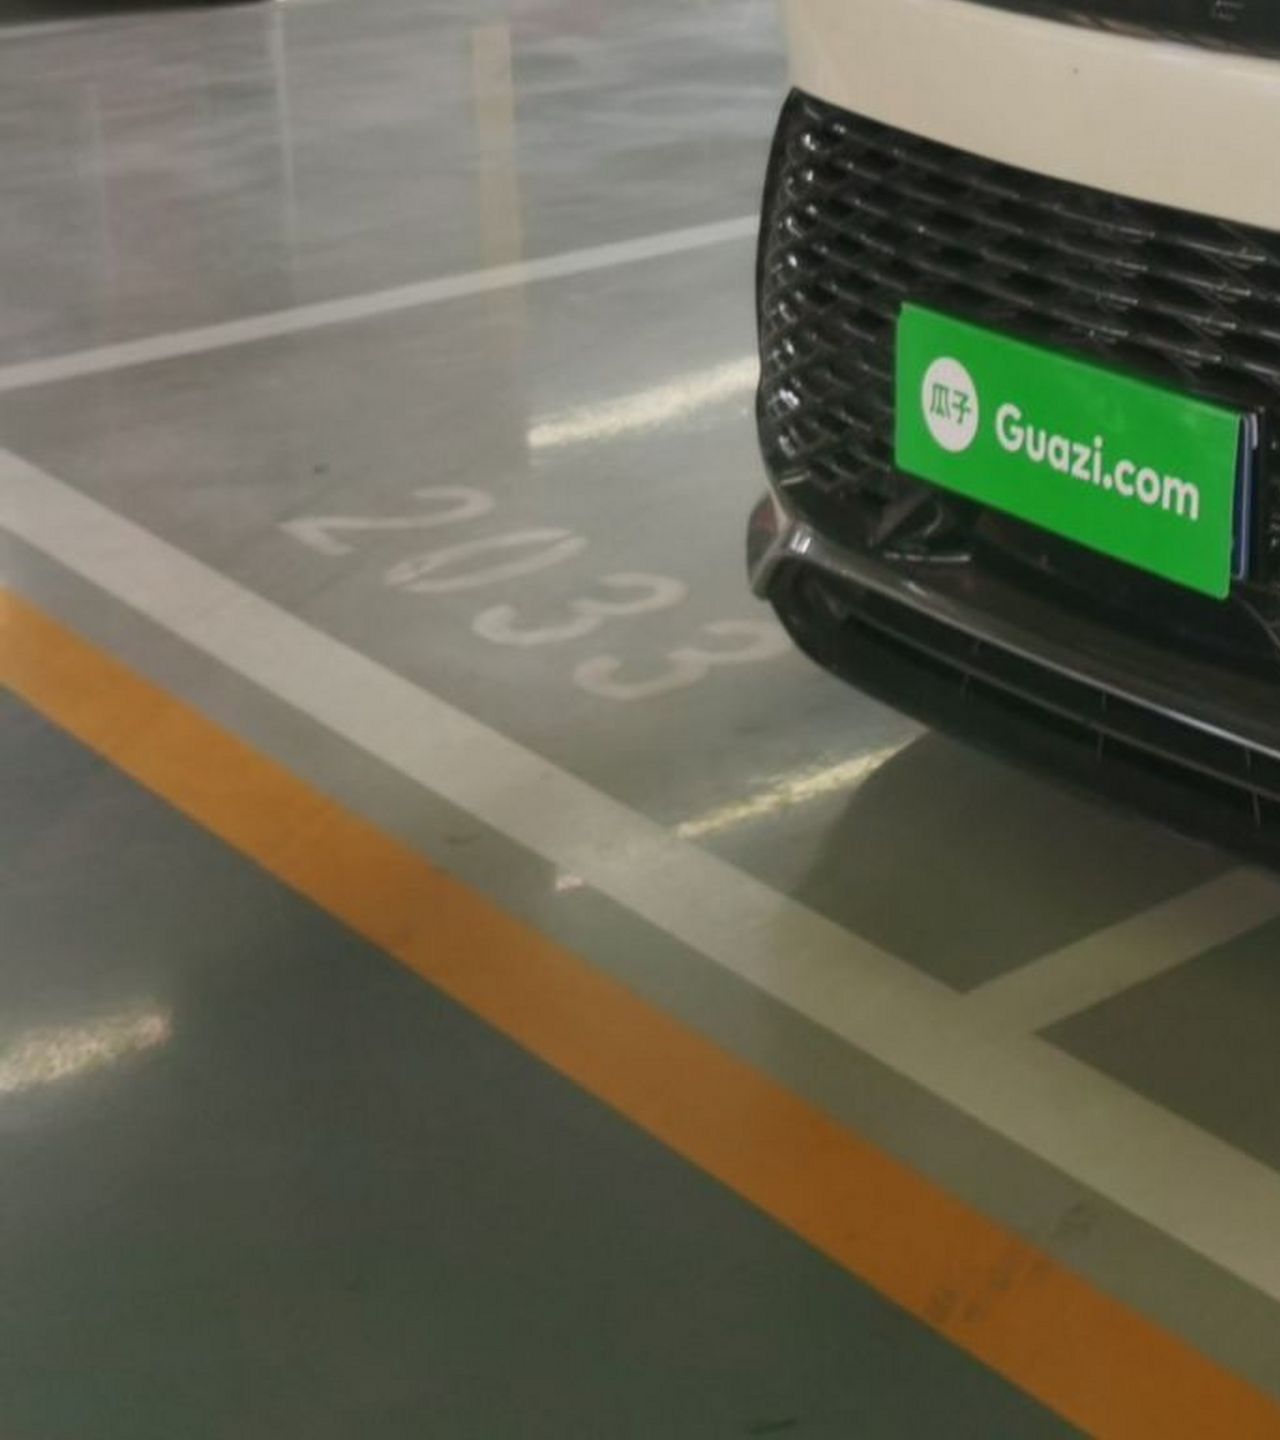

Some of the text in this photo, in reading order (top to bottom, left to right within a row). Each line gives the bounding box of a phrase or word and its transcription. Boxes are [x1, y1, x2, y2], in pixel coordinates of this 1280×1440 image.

[929, 382, 972, 425] 瓜子
[995, 402, 1200, 522] Guazi.com
[279, 484, 794, 700] 2033
